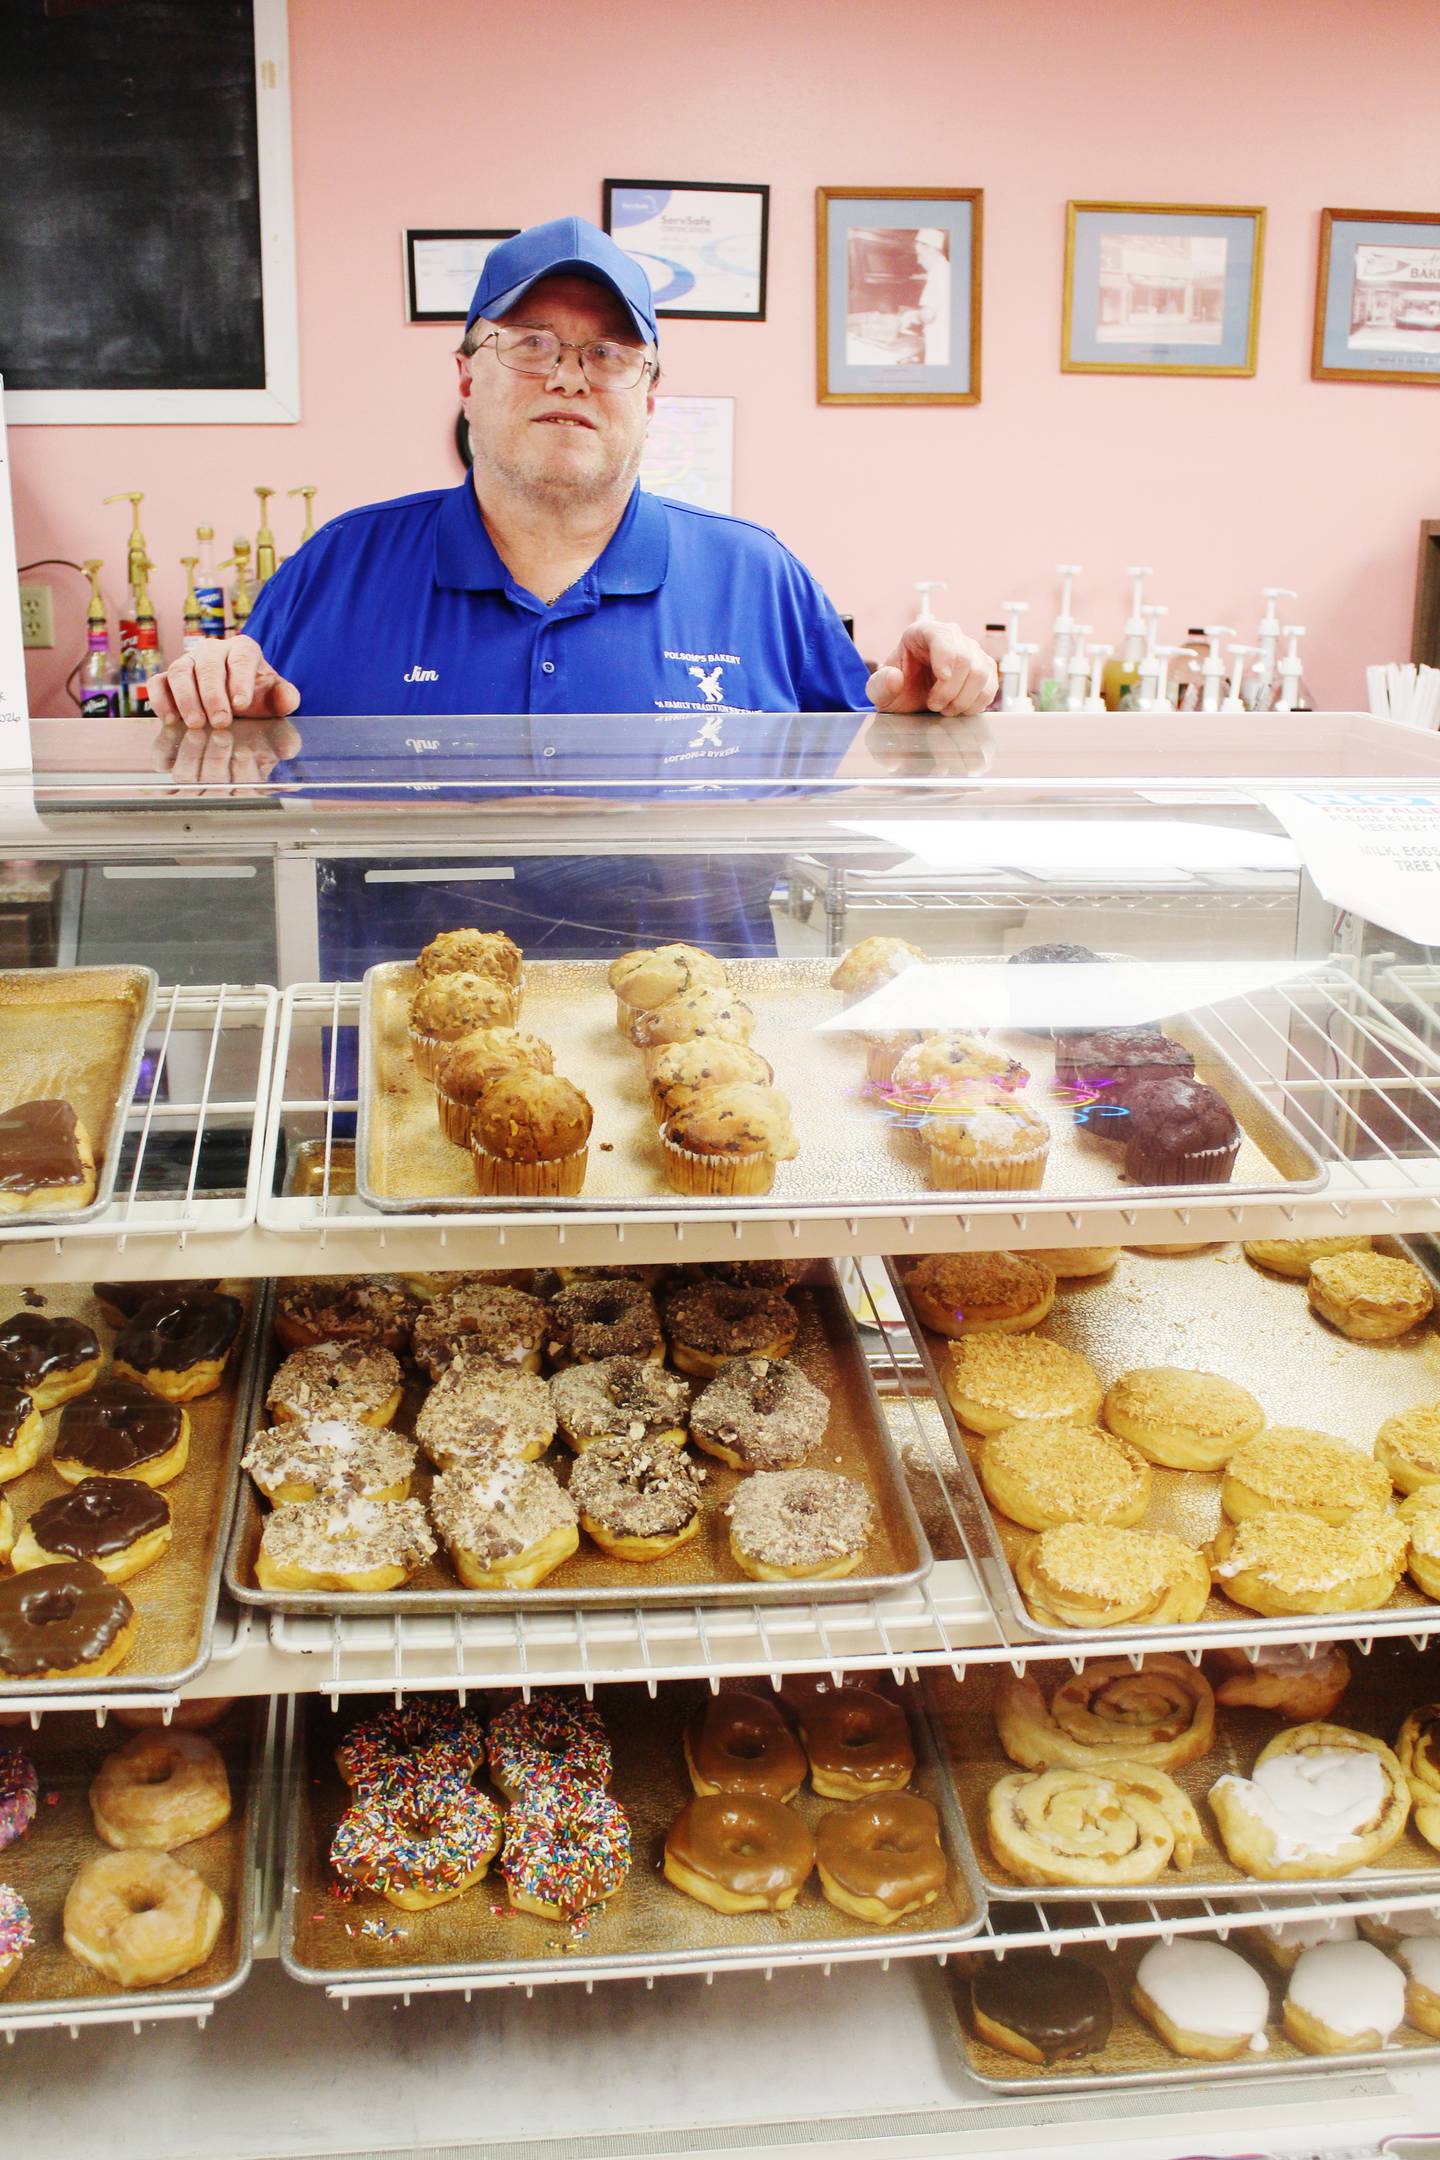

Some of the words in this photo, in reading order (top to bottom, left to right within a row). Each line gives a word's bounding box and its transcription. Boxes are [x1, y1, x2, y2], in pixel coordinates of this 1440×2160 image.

[708, 653, 741, 664] BAKERY
[403, 665, 439, 682] Jim
[1394, 861, 1434, 872] TREE
